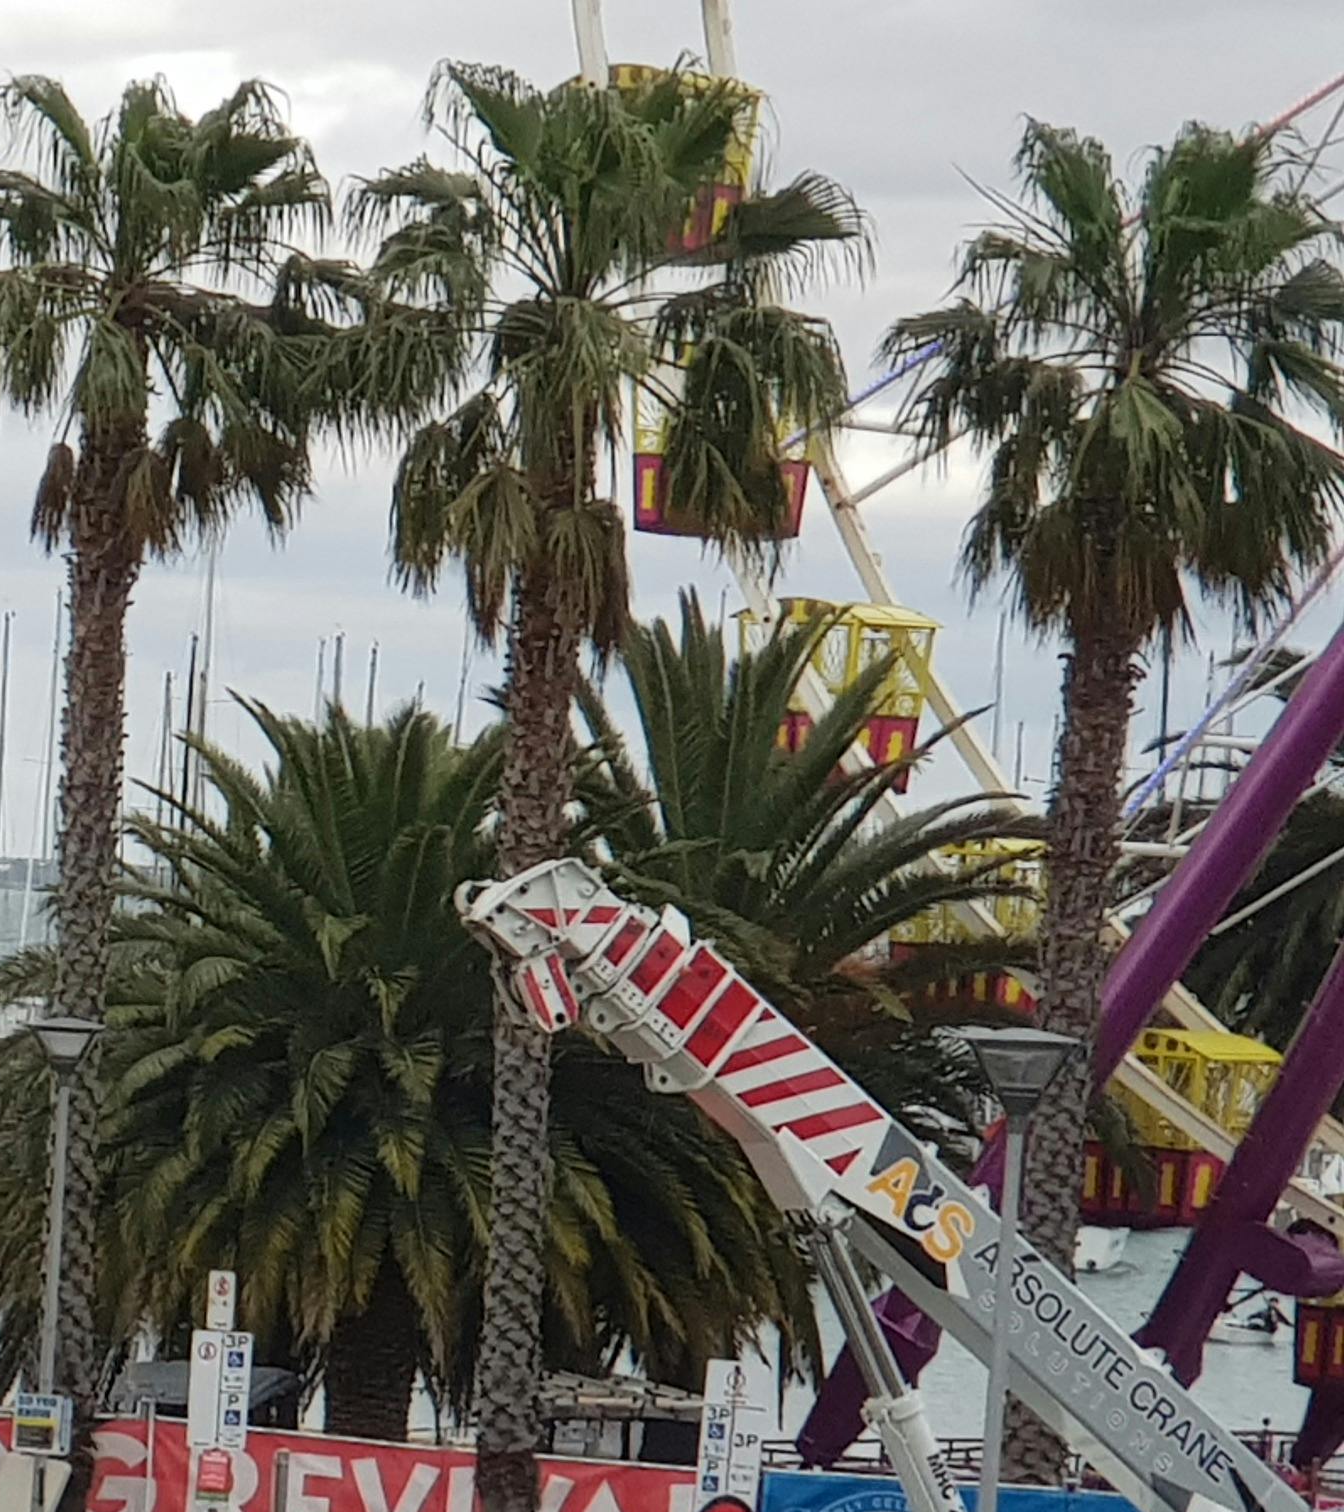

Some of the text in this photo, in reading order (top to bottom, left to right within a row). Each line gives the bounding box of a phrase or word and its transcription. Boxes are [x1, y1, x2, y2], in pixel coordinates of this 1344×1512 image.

[733, 1432, 759, 1448] 3P
[1128, 1380, 1234, 1484] CRANE
[927, 1453, 955, 1500] MHC
